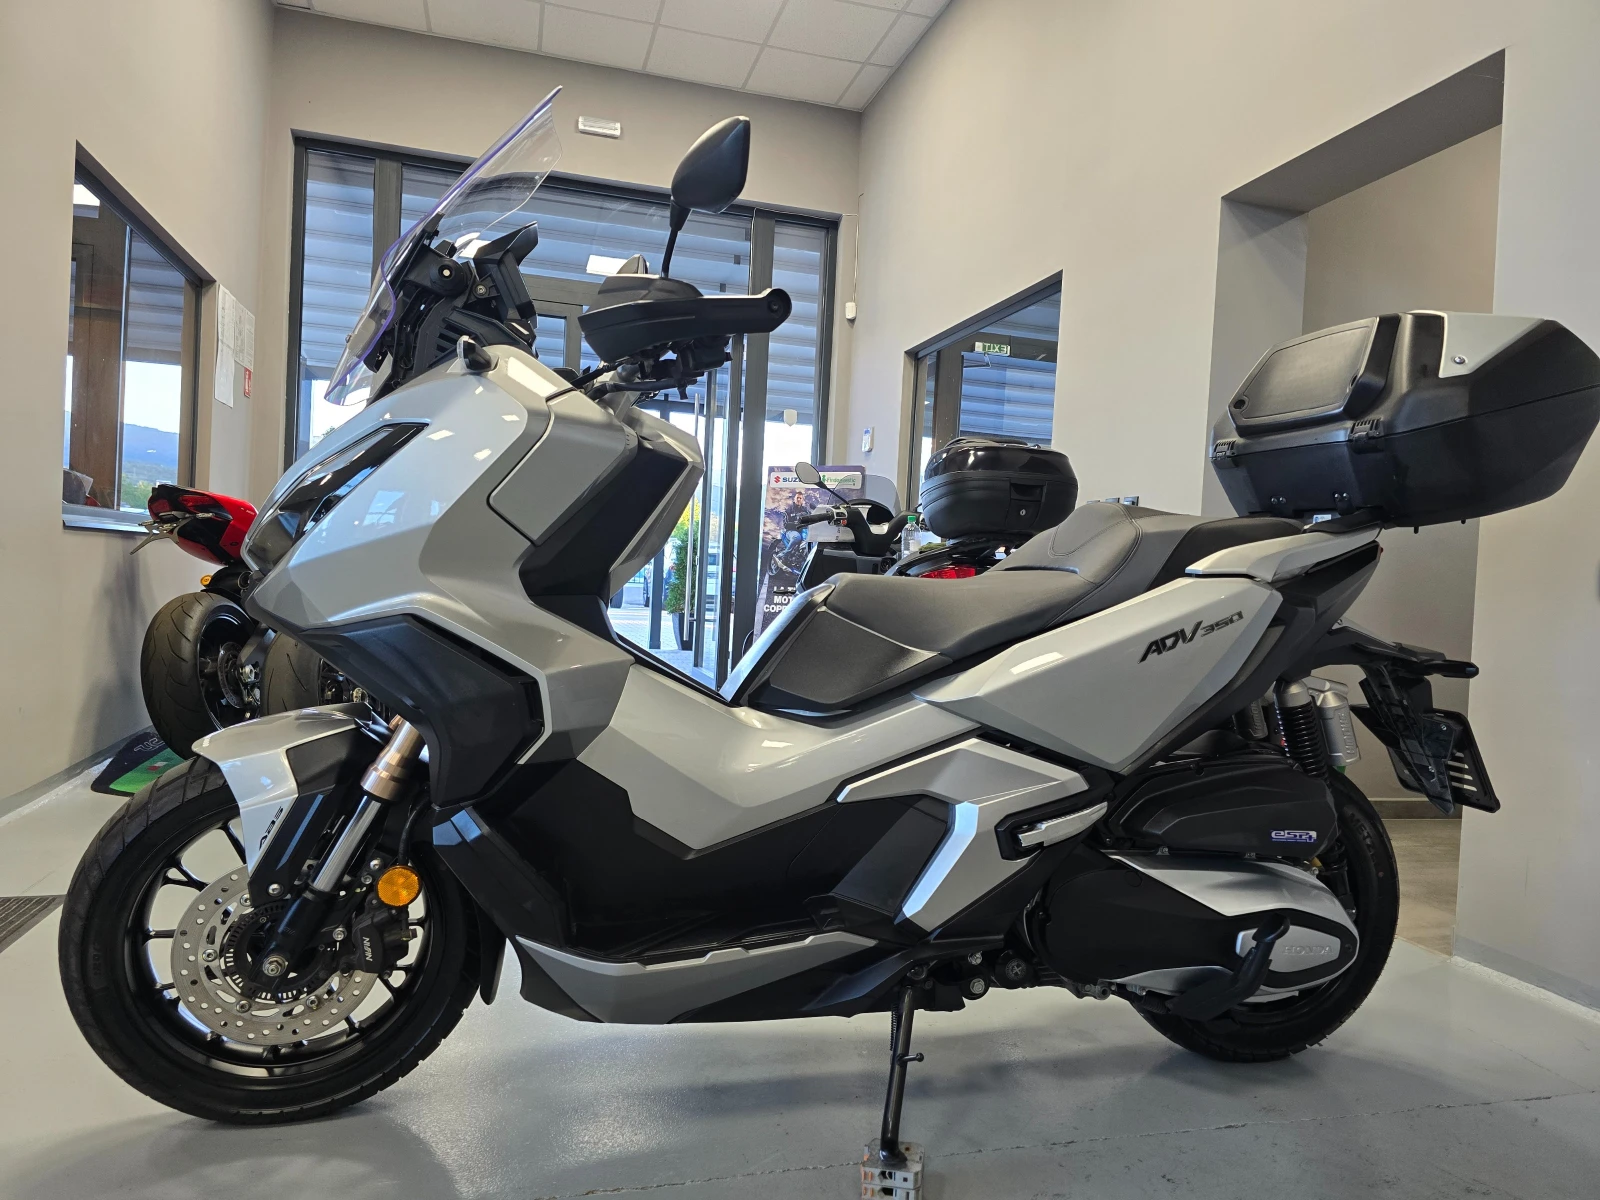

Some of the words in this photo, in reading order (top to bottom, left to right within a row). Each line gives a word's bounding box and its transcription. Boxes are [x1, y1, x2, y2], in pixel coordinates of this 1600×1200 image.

[773, 596, 793, 604] MOT
[258, 805, 284, 851] ABS
[1282, 944, 1335, 956] HONDA
